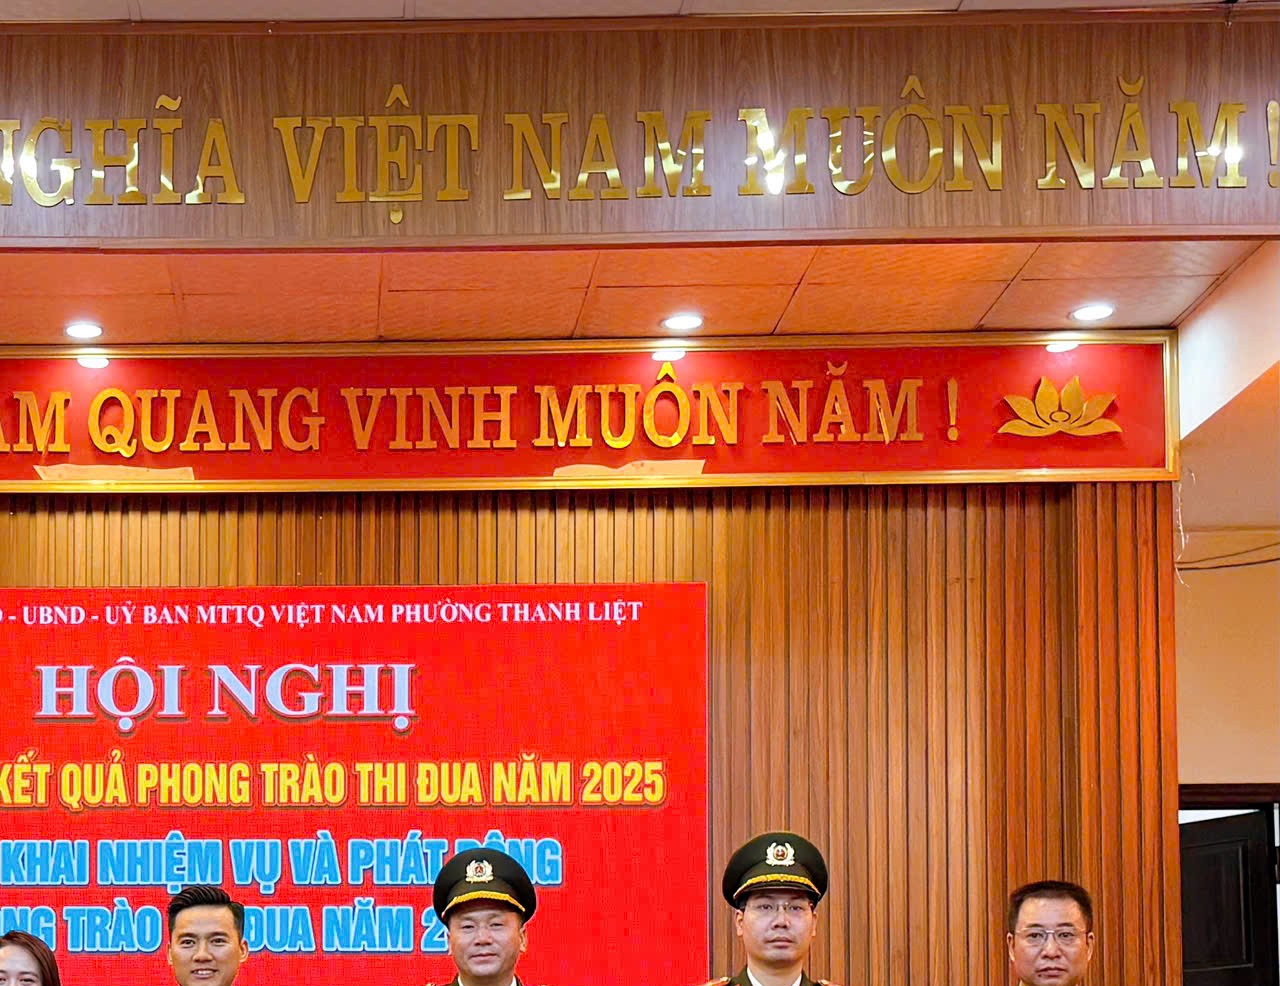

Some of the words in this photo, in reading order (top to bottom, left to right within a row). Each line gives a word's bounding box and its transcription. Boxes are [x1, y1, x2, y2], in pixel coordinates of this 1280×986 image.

[273, 84, 480, 224] VIỆT
[503, 110, 712, 201] NAM
[737, 76, 1011, 196] MUÔN
[1035, 75, 1248, 189] NĂM
[1266, 100, 1280, 188] !
[87, 386, 327, 459] QUANG
[340, 385, 518, 450] VINH
[533, 361, 744, 449] MUÔN
[760, 359, 924, 446] NĂM
[947, 377, 960, 442] !
[23, 606, 86, 625] UBND
[143, 605, 189, 624] BAN
[196, 604, 265, 627] MTTQ
[270, 602, 325, 628] VIỆT
[331, 604, 385, 624] NAM
[391, 598, 491, 623] PHƯỜNG
[501, 602, 581, 622] THANH
[588, 599, 643, 626] LIỆT
[34, 656, 186, 732] HỘI
[207, 662, 418, 731] NGHỊ
[61, 749, 128, 810] QUẢ
[137, 761, 251, 806] PHONG
[260, 753, 346, 805] TRÀO
[355, 760, 408, 804] THI
[417, 760, 484, 804] ĐUA
[493, 755, 573, 804] NĂM
[581, 760, 666, 804] 2025
[97, 830, 223, 894] NHIỆM
[230, 838, 282, 895] VỤ
[288, 830, 342, 885] VÀ
[348, 829, 448, 885] PHÁT
[455, 829, 563, 885] NG
[63, 897, 163, 952] TRÀO
[323, 898, 415, 953] NĂM
